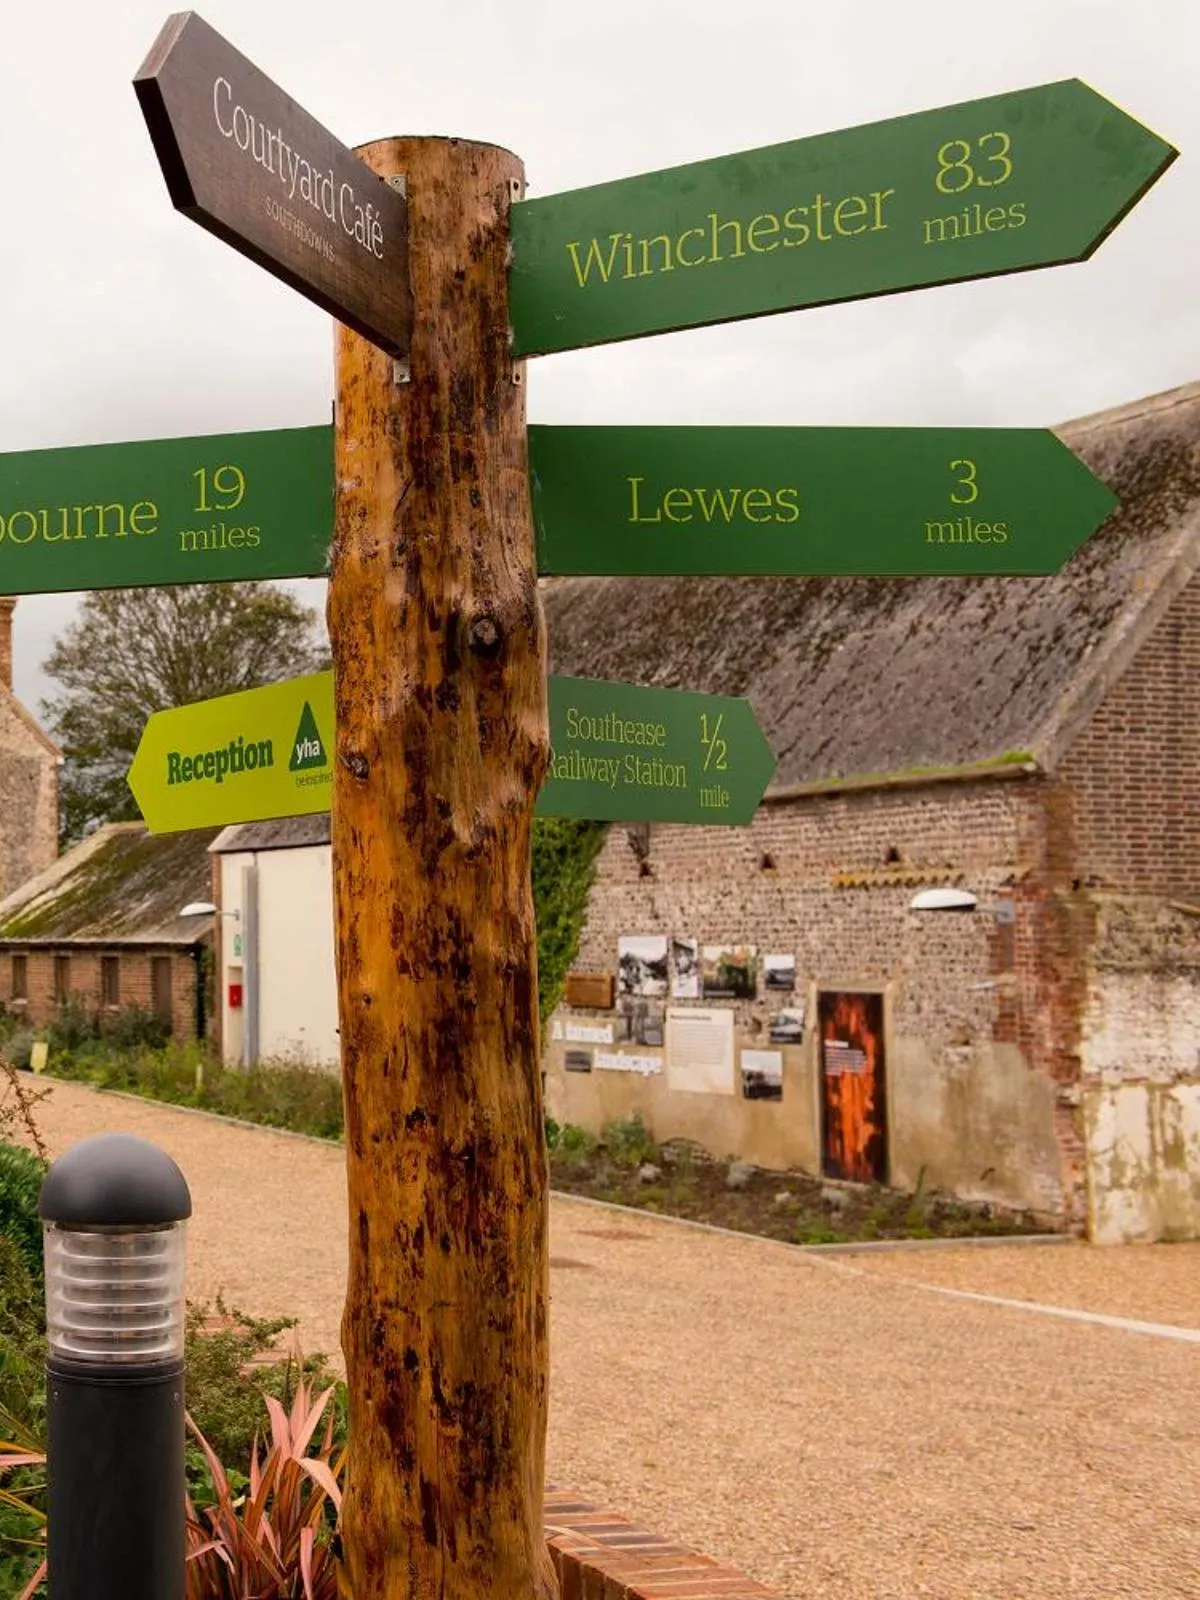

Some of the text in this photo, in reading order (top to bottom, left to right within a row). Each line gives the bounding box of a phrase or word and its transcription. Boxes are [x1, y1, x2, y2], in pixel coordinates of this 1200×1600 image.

[213, 76, 384, 260] Courtyard Café
[935, 131, 1013, 194] 83
[566, 187, 894, 287] Winchester
[923, 202, 1027, 245] miles
[192, 463, 245, 513] 19
[627, 477, 800, 523] Lewes
[948, 459, 979, 504] 3
[179, 521, 261, 552] miles
[925, 516, 1008, 544] miles
[566, 707, 666, 747] Southease
[167, 735, 274, 784] Reception
[296, 737, 320, 765] yha
[624, 754, 687, 788] Station
[700, 785, 730, 808] mile
